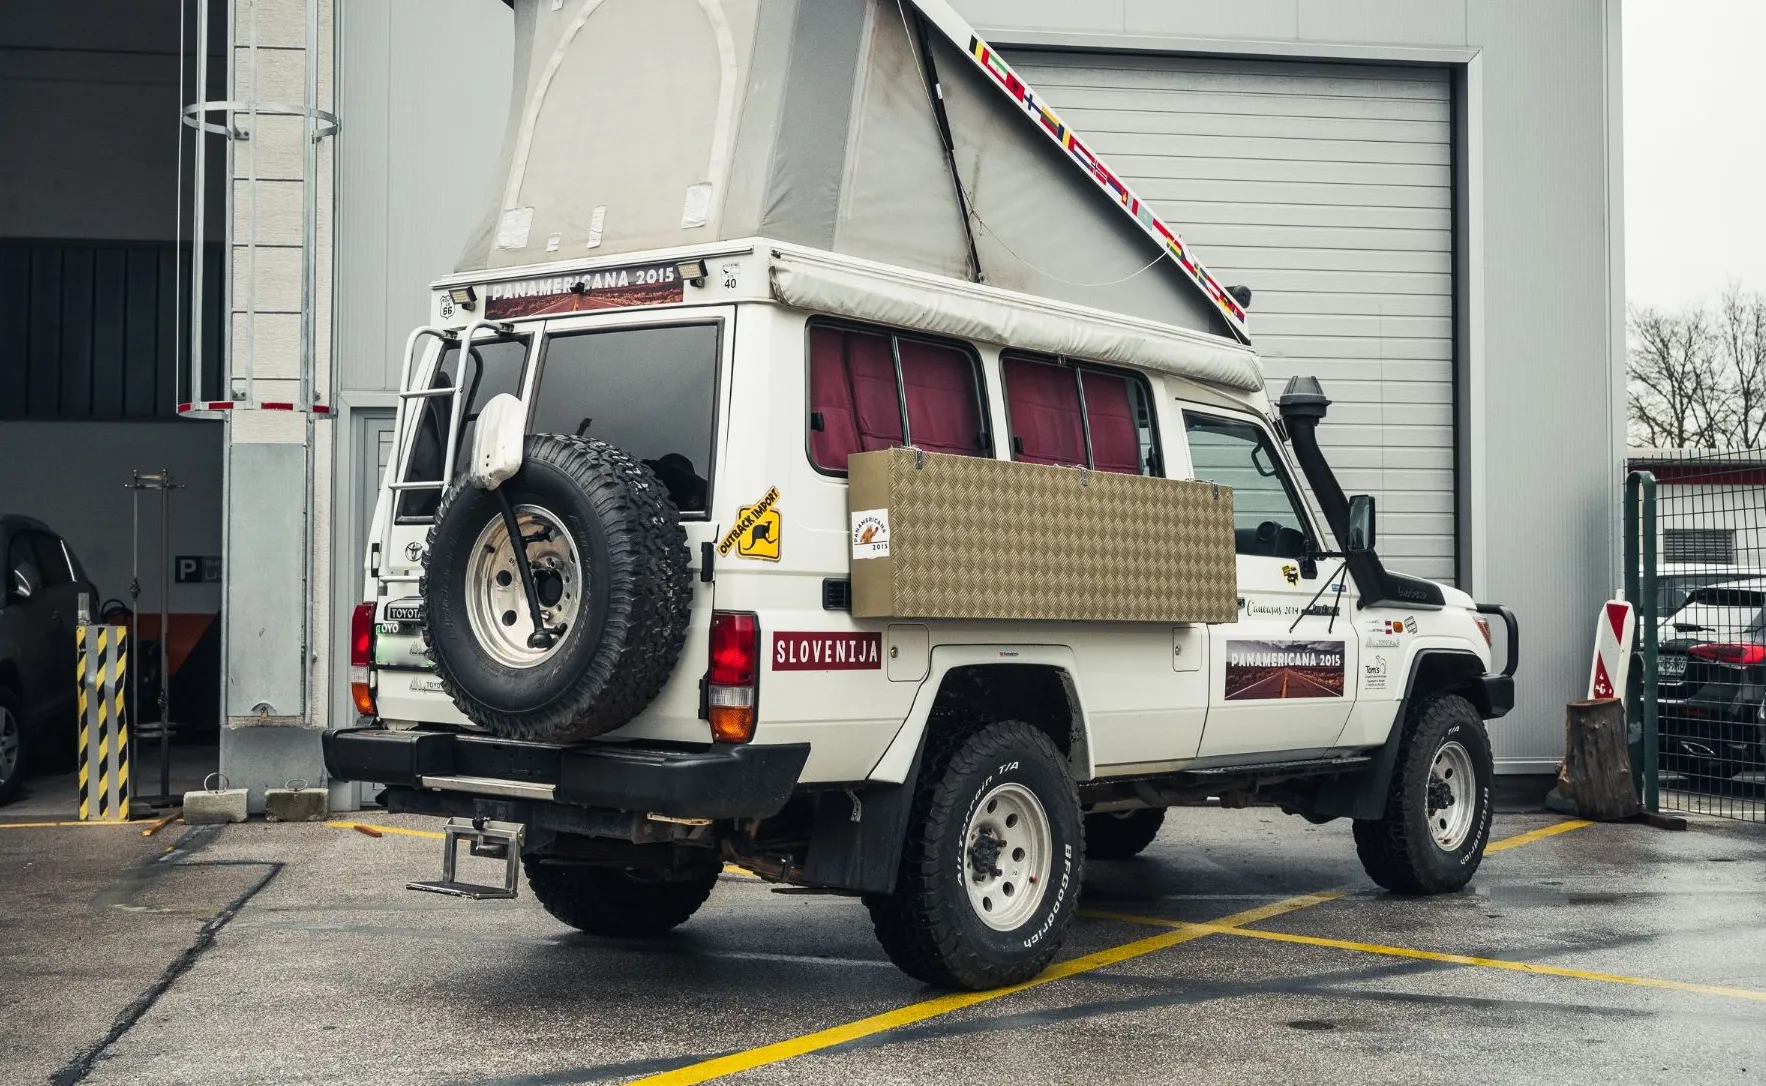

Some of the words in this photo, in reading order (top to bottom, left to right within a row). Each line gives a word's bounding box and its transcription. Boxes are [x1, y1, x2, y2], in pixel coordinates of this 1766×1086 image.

[491, 270, 629, 301] PANAMERICANA
[636, 266, 675, 286] 2015
[724, 278, 737, 289] 40
[443, 306, 453, 316] 66
[720, 514, 756, 554] OUTBACK
[751, 488, 780, 523] IMPORT
[853, 516, 887, 543] PANAMERICANA
[872, 543, 888, 551] 2015
[1284, 606, 1299, 615] 2014
[776, 640, 878, 663] SLOVENIJA
[1231, 652, 1317, 667] PANAMERICANA
[1319, 653, 1341, 667] 2015
[1365, 665, 1380, 674] Tom's
[998, 761, 1020, 775] T/A
[1460, 786, 1490, 866] BFGoodrich
[1023, 843, 1072, 949] BFGoodrich
